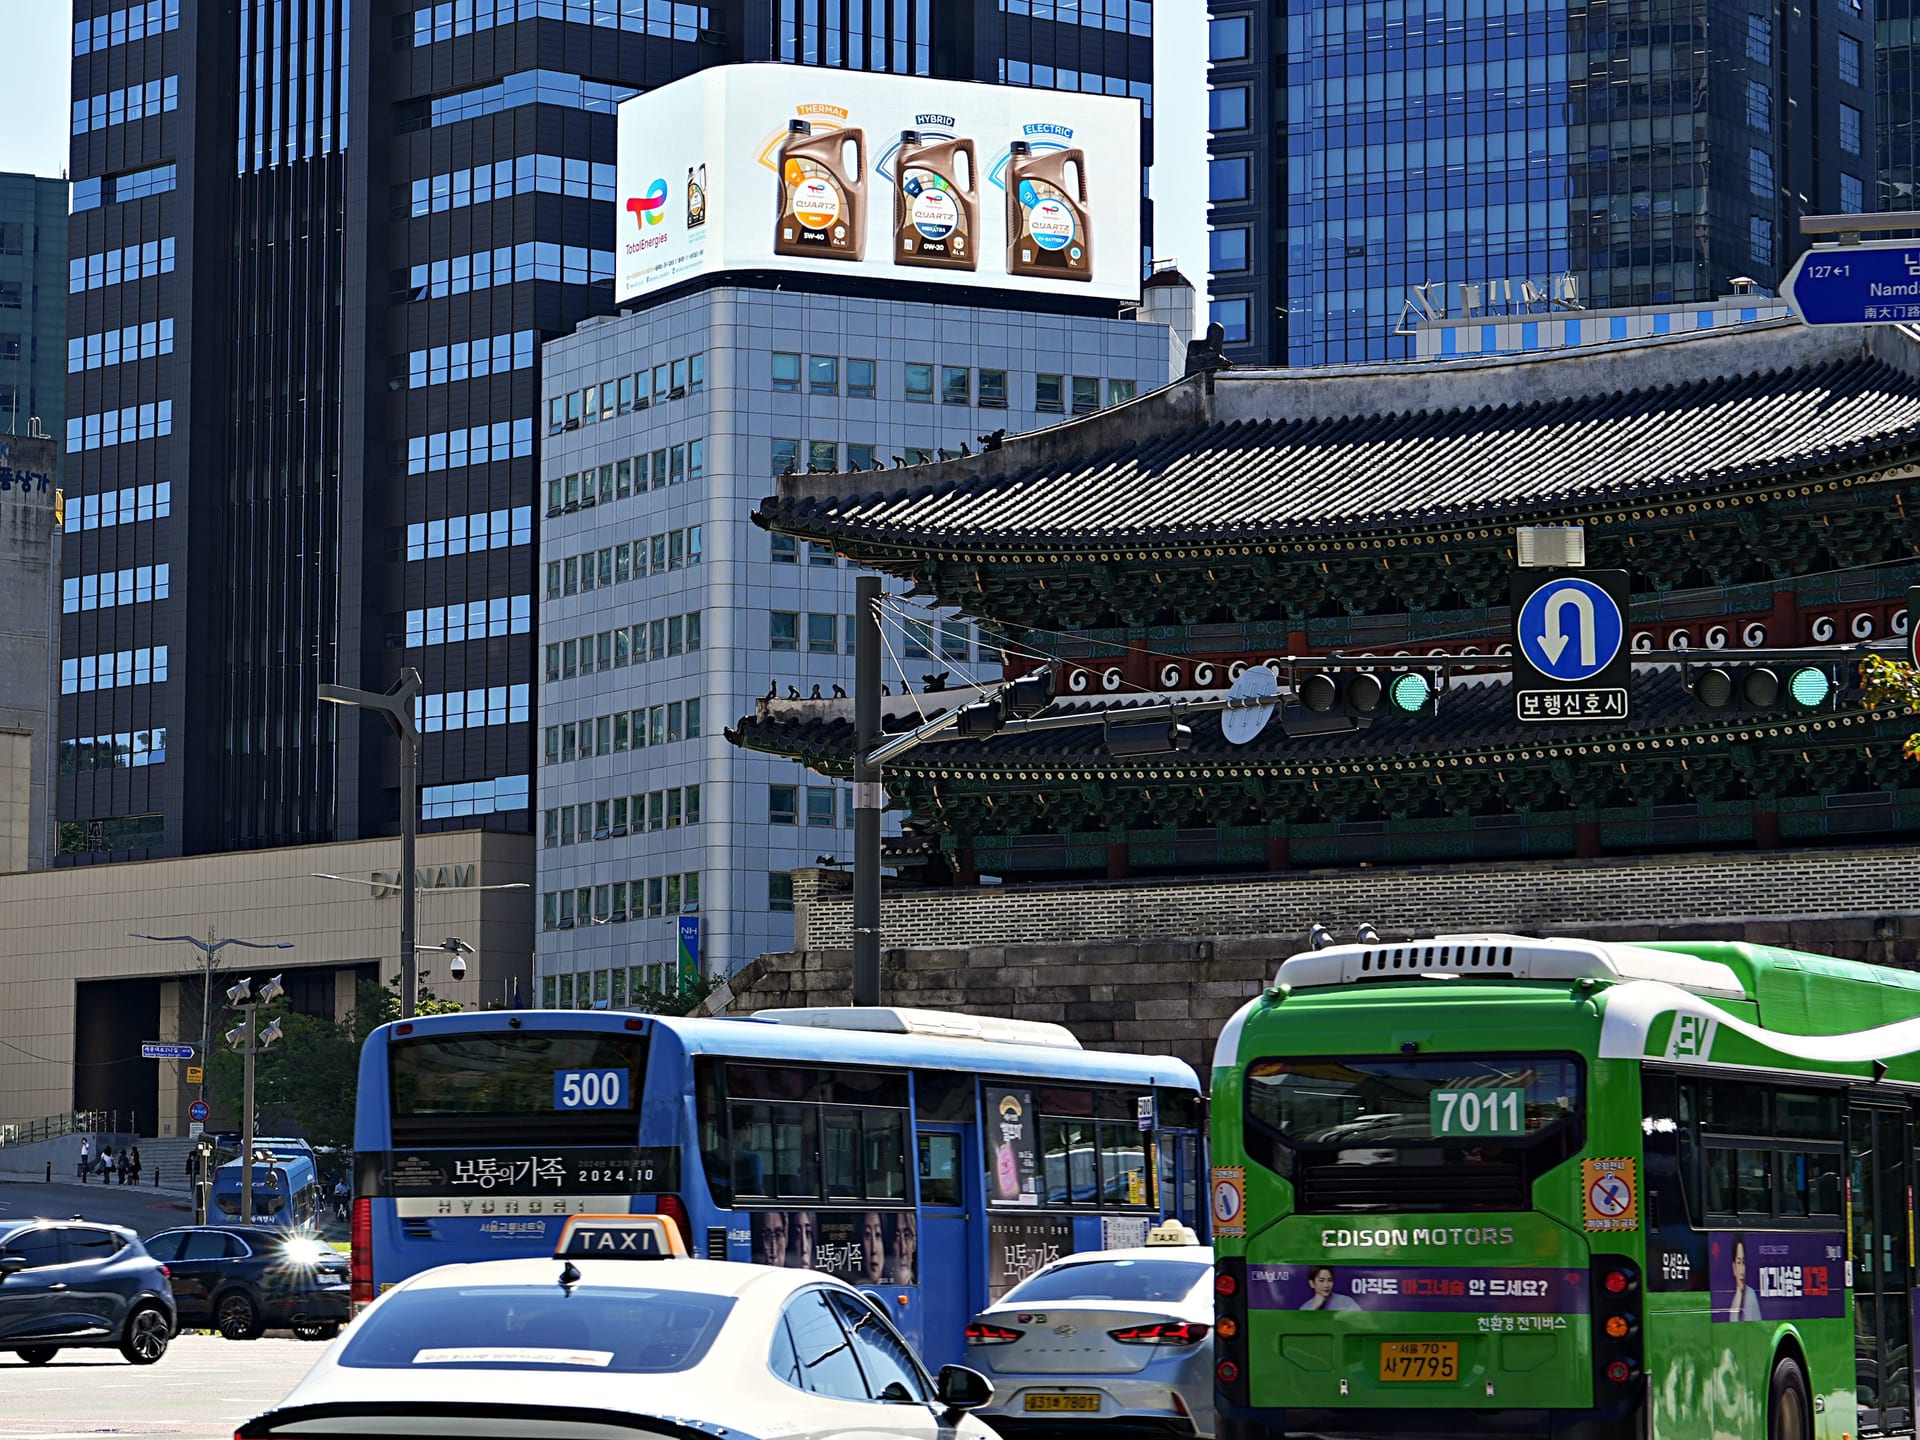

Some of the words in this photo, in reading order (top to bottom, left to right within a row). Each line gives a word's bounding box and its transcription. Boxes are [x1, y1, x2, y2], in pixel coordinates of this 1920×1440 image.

[799, 105, 845, 118] THERMAL
[917, 115, 954, 127] HYBRID
[1026, 124, 1072, 138] ELECTRIC
[795, 200, 837, 211] QUARTZ
[914, 210, 955, 221] QUARTZ
[1031, 221, 1071, 232] QUARTZ
[803, 231, 826, 241] 5W-40
[625, 232, 669, 256] TotalEnergies
[1870, 281, 1920, 297] Namd
[1523, 693, 1622, 716] 보행신호시
[681, 926, 697, 935] NH
[1674, 1015, 1710, 1058] EV
[562, 1072, 620, 1107] 500
[1437, 1091, 1518, 1132] 7011
[578, 1169, 654, 1182] 2024.10
[438, 1202, 585, 1215] HYUNDAI
[579, 1231, 650, 1250] TAXI
[1153, 1233, 1179, 1242] TAXI
[1322, 1229, 1408, 1247] EDISON
[1413, 1227, 1514, 1246] MOTORS
[1351, 1278, 1398, 1295] 아직도
[1402, 1279, 1465, 1296] 마그네슘
[1469, 1279, 1486, 1296] 안
[1489, 1280, 1548, 1297] 드세요?
[1477, 1316, 1514, 1331] 친환경
[1517, 1316, 1567, 1331] 전기버스
[1400, 1344, 1418, 1354] 서울
[1422, 1343, 1440, 1354] 70
[1384, 1357, 1398, 1373] 사
[1400, 1356, 1454, 1377] 7795
[1063, 1394, 1094, 1409] 7801
